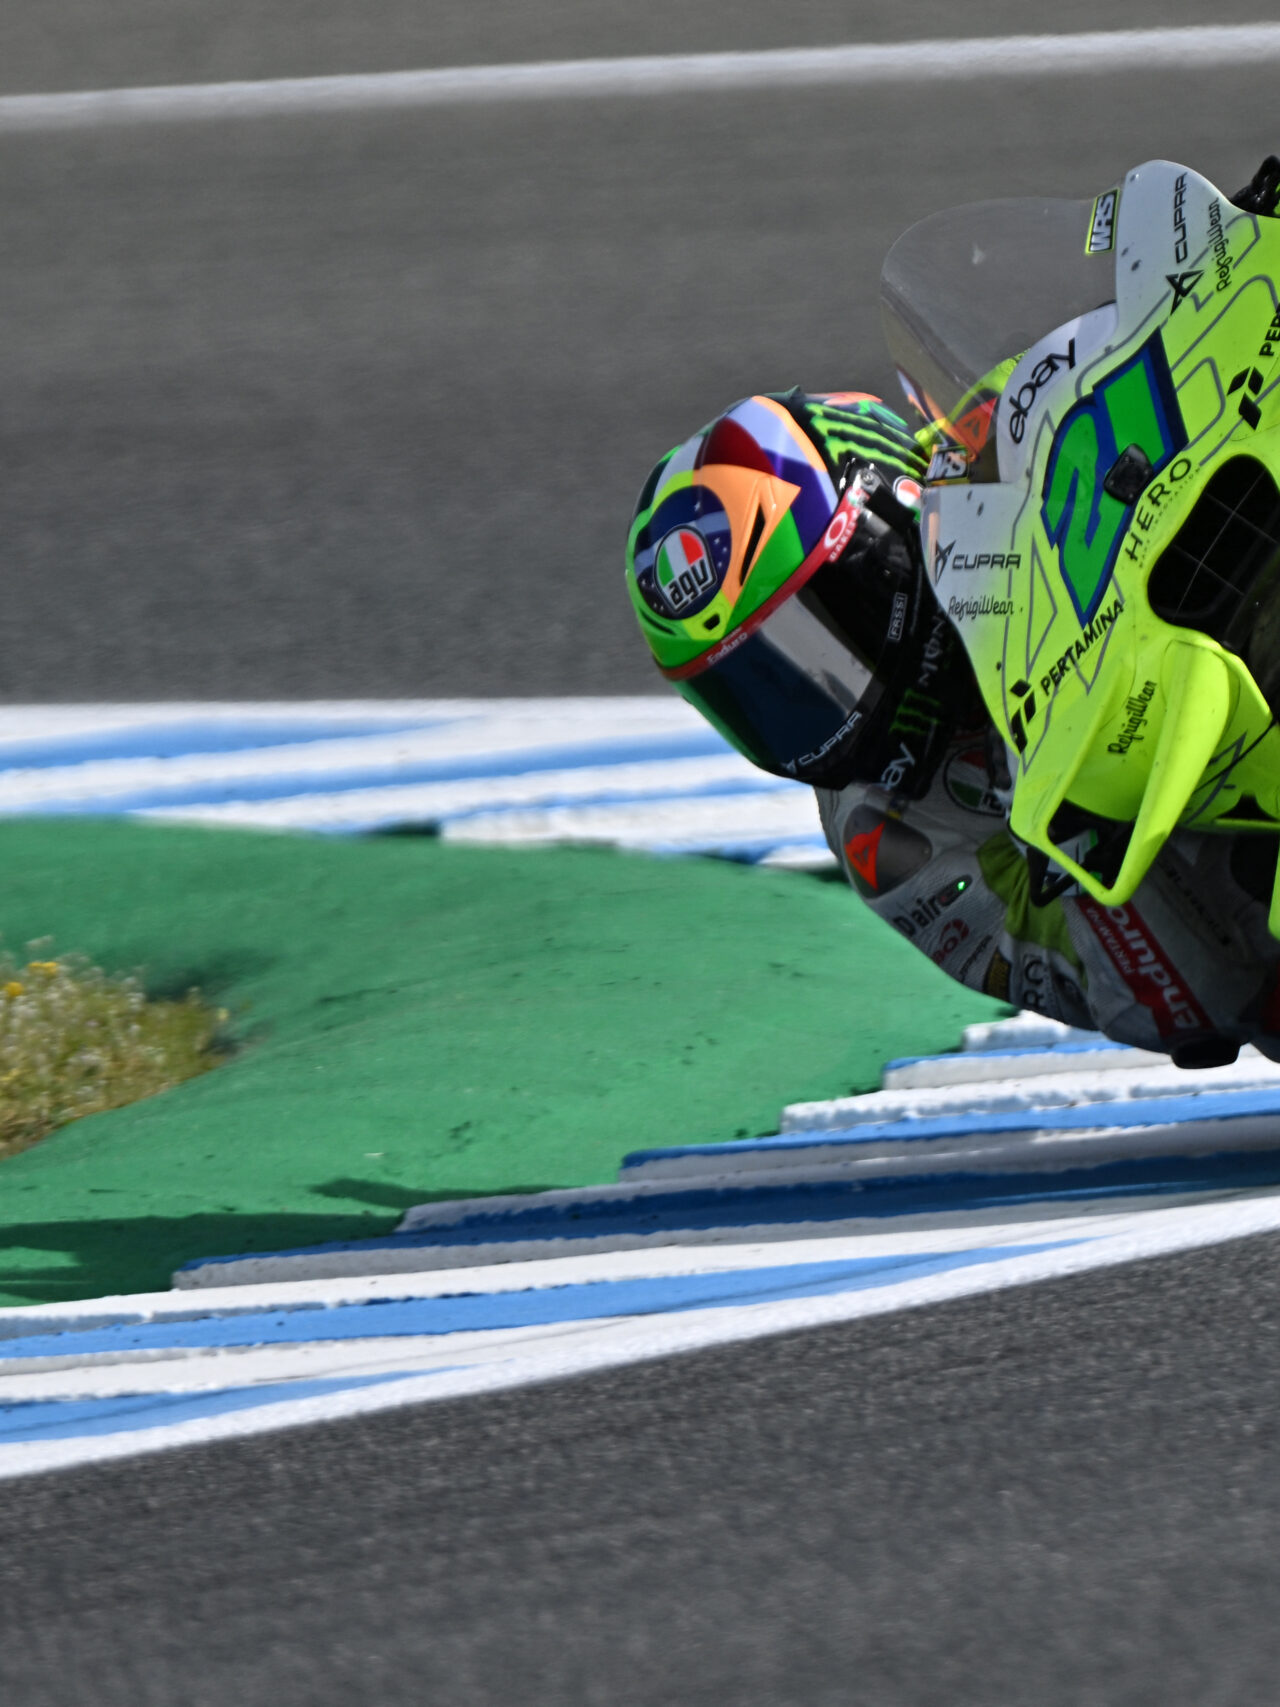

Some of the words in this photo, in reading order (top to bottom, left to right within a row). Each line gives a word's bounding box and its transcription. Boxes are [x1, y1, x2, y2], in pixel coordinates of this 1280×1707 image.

[1089, 191, 1117, 251] WRS
[1174, 172, 1188, 263] CUPRA
[1207, 196, 1232, 292] RefrigiWear
[1009, 338, 1077, 444] ebay
[1040, 326, 1190, 629] 21
[1125, 457, 1192, 562] HERO
[667, 562, 709, 606] agv
[952, 553, 1020, 569] CUPRA
[948, 595, 1014, 620] RefrigiWear
[1039, 599, 1124, 696] PERTAMINA
[799, 712, 862, 765] CUPRA
[1108, 680, 1157, 755] RefrigiWear
[1086, 906, 1135, 974] PERTAMINA
[1104, 903, 1199, 1029] Enduro
